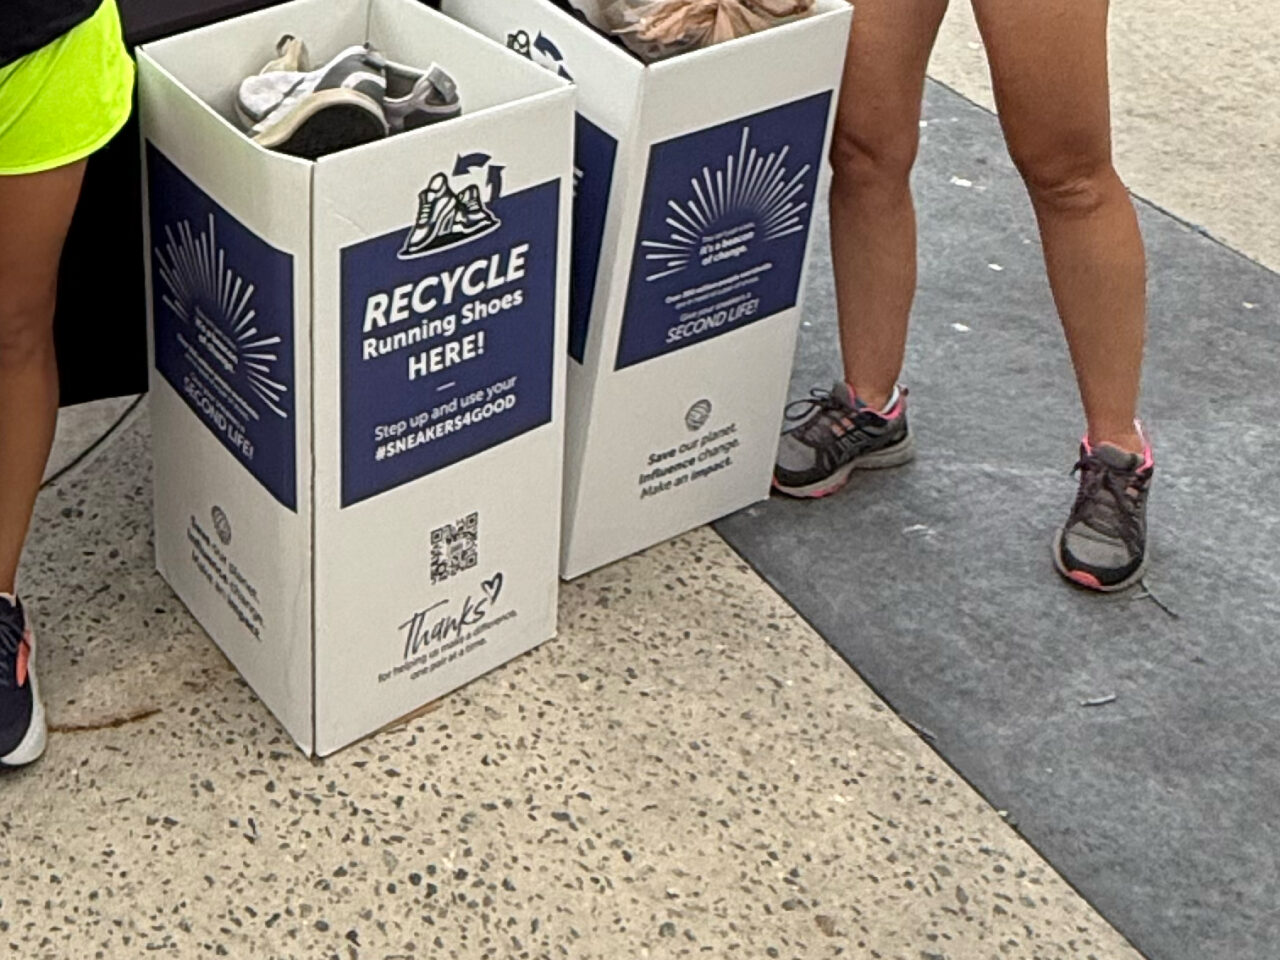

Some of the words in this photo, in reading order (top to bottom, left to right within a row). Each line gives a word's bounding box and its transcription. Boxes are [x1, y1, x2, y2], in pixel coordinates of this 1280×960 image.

[363, 243, 529, 333] RECYCLE
[666, 311, 727, 344] SECOND
[728, 297, 759, 323] LIFE!
[363, 314, 456, 360] Running
[461, 289, 523, 325] Shoes
[408, 331, 485, 381] HERE!
[374, 420, 408, 442] Step
[409, 412, 429, 428] up
[430, 398, 458, 420] and
[460, 390, 485, 409] use
[485, 376, 518, 401] your
[374, 394, 517, 462] #SNEAKERS4GOOD
[648, 448, 676, 466] Save
[678, 439, 700, 453] our
[640, 480, 672, 500] Make
[397, 595, 488, 660] Thanks
